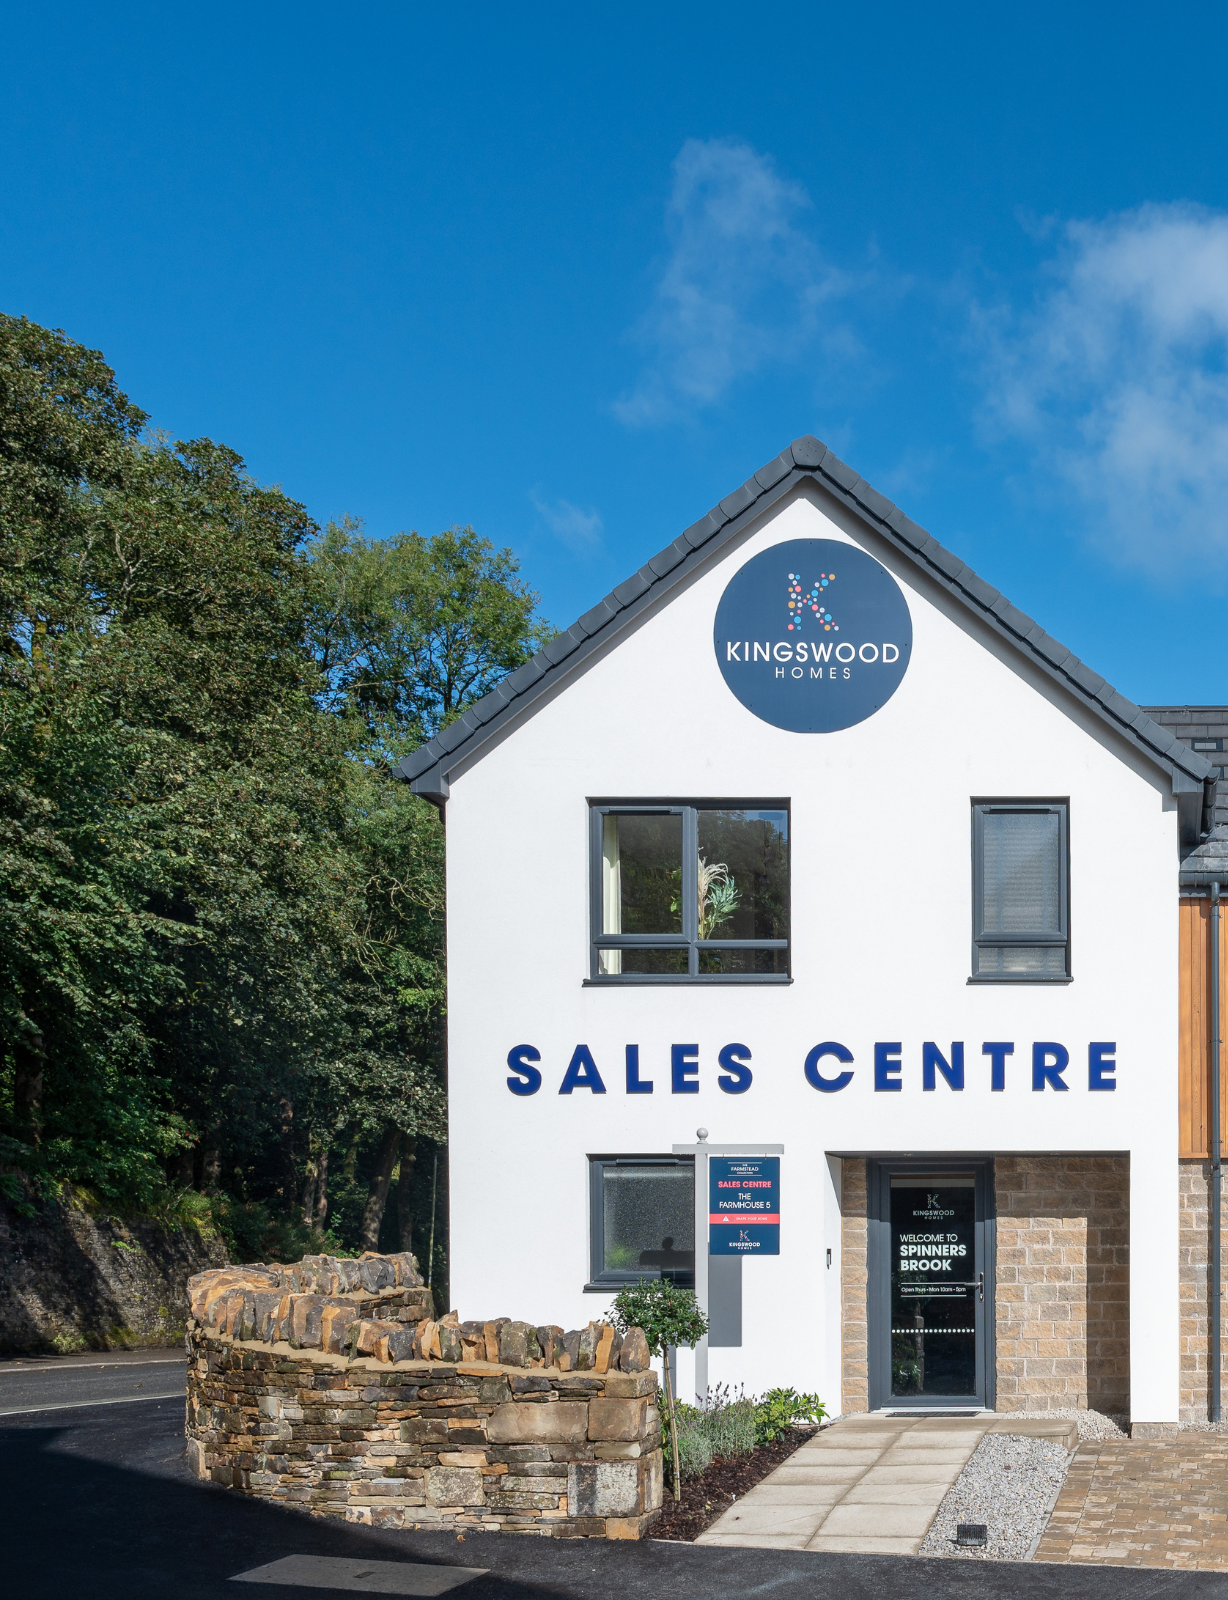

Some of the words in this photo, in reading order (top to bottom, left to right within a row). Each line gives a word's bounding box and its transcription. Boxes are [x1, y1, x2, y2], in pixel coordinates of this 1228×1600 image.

[726, 641, 900, 663] KINGSWOOD
[775, 666, 851, 679] HOMES
[506, 1042, 754, 1096] SALES
[804, 1041, 1117, 1093] CENTRE
[719, 1201, 765, 1209] FARMHOUSE
[766, 1201, 771, 1209] 5
[900, 1234, 945, 1242] WELCOME
[946, 1234, 958, 1242] TO
[900, 1244, 967, 1256] SPINNERS
[900, 1259, 952, 1271] BROOK
